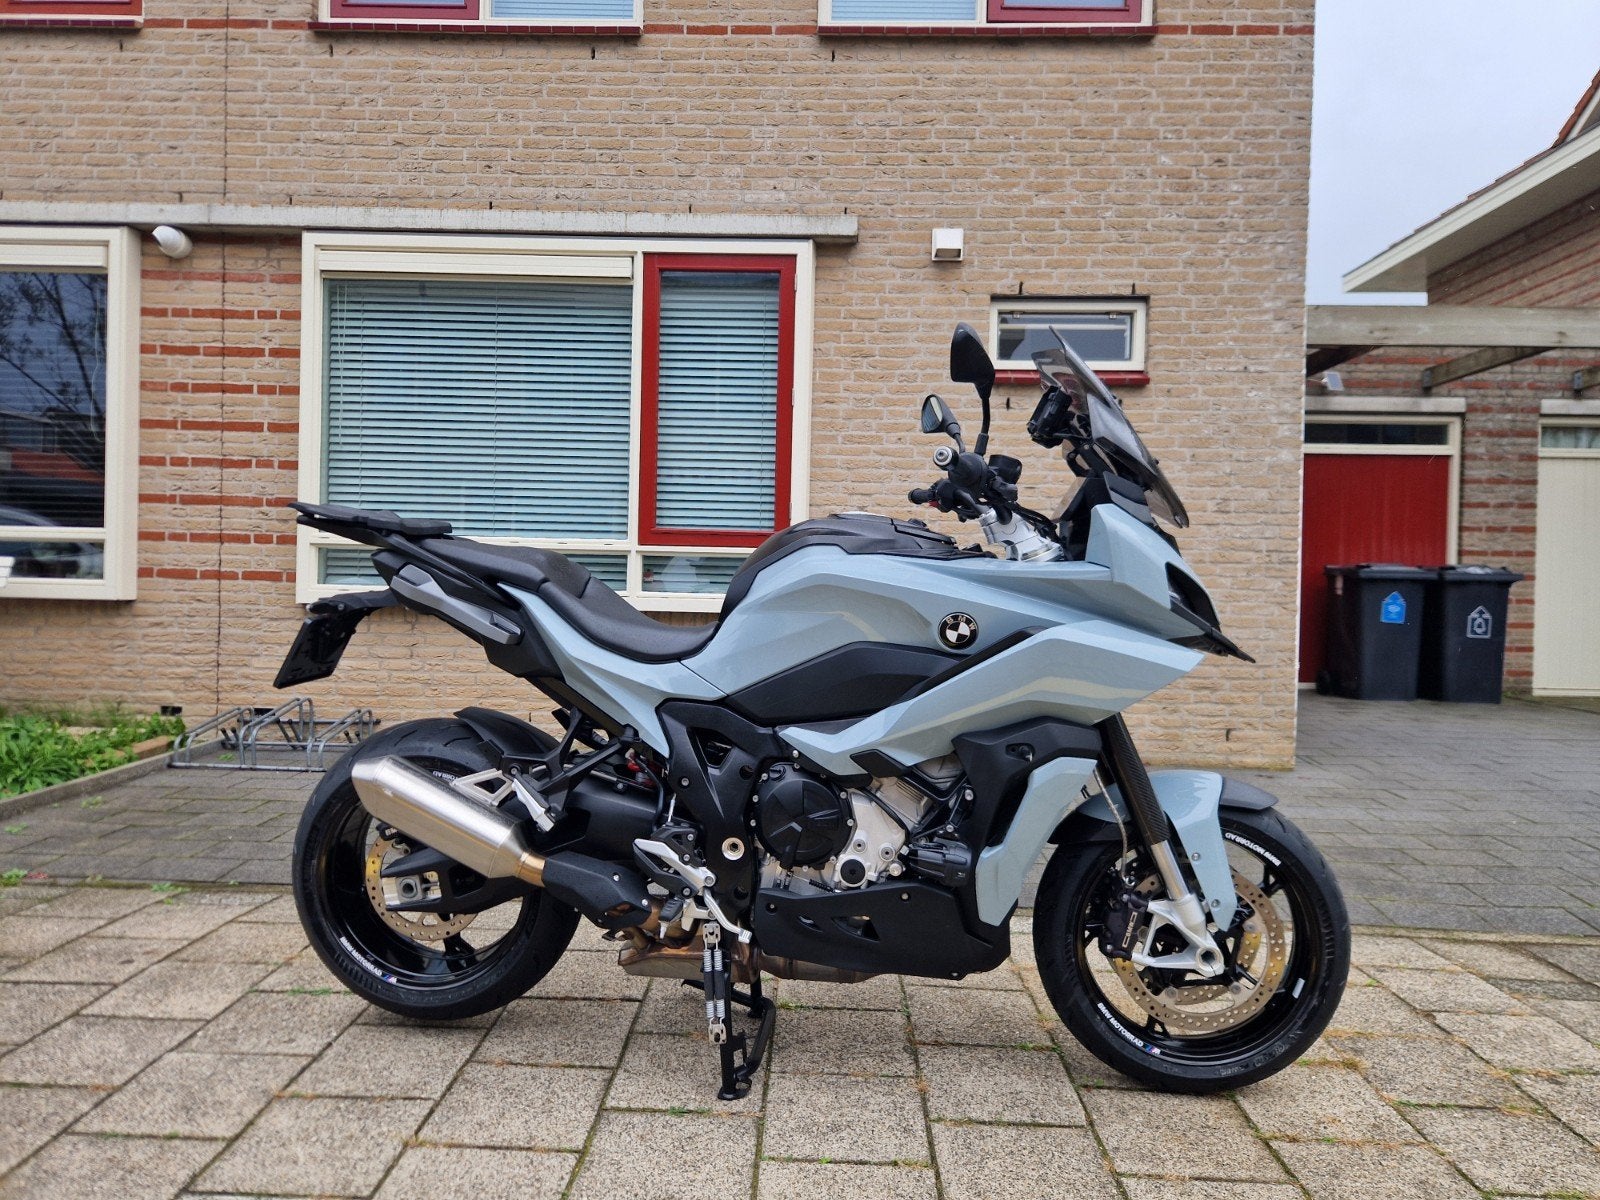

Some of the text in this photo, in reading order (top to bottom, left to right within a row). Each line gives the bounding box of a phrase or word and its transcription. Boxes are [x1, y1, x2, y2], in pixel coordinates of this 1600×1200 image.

[946, 616, 976, 630] BMW
[1225, 832, 1282, 867] BMW MOTORRAD
[1097, 1002, 1112, 1019] BMW
[1109, 1018, 1144, 1047] MOTORRAD
